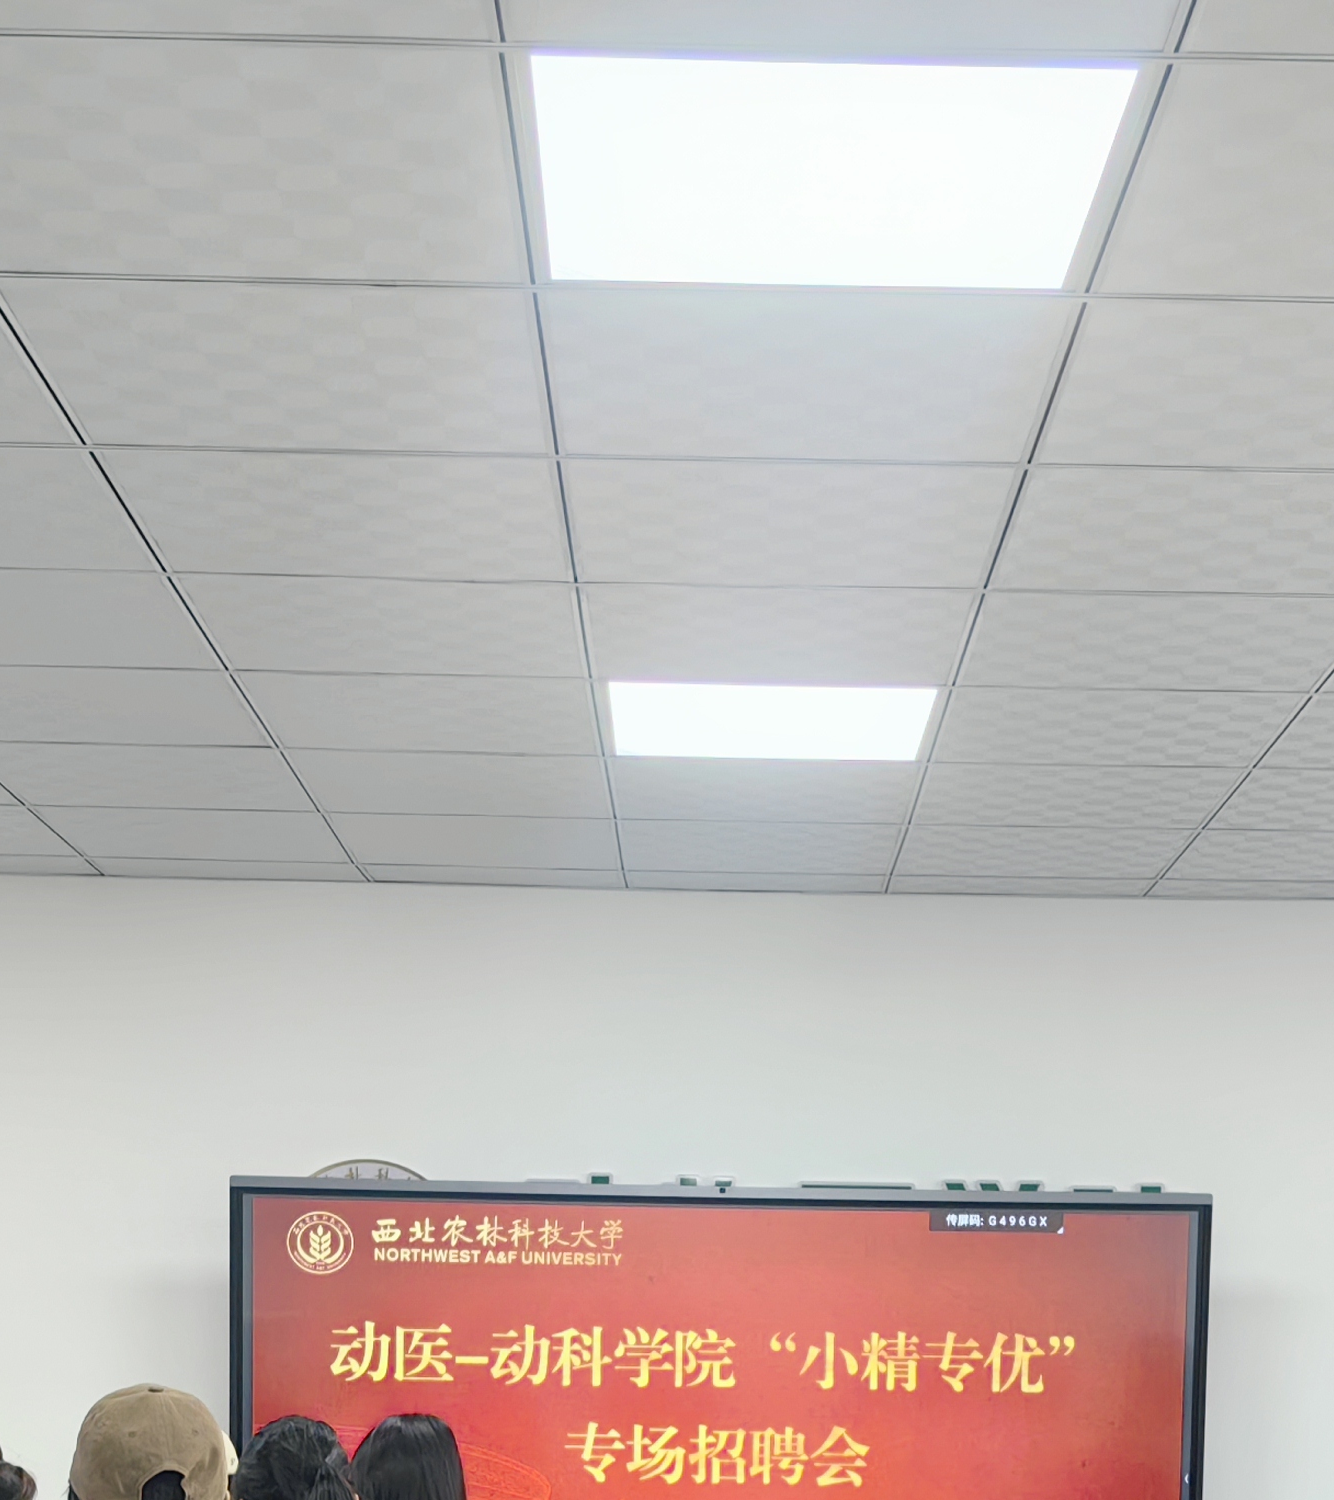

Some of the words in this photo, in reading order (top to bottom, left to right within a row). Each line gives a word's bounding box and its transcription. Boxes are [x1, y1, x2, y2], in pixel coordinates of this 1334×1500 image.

[371, 1215, 624, 1249] 西北农林科技大学
[988, 1215, 1048, 1227] G496GX
[374, 1247, 481, 1263] NORTHWEST
[484, 1248, 518, 1264] A&F
[521, 1249, 623, 1266] UNIVERSITY
[564, 1421, 871, 1487] 专场招聘会
